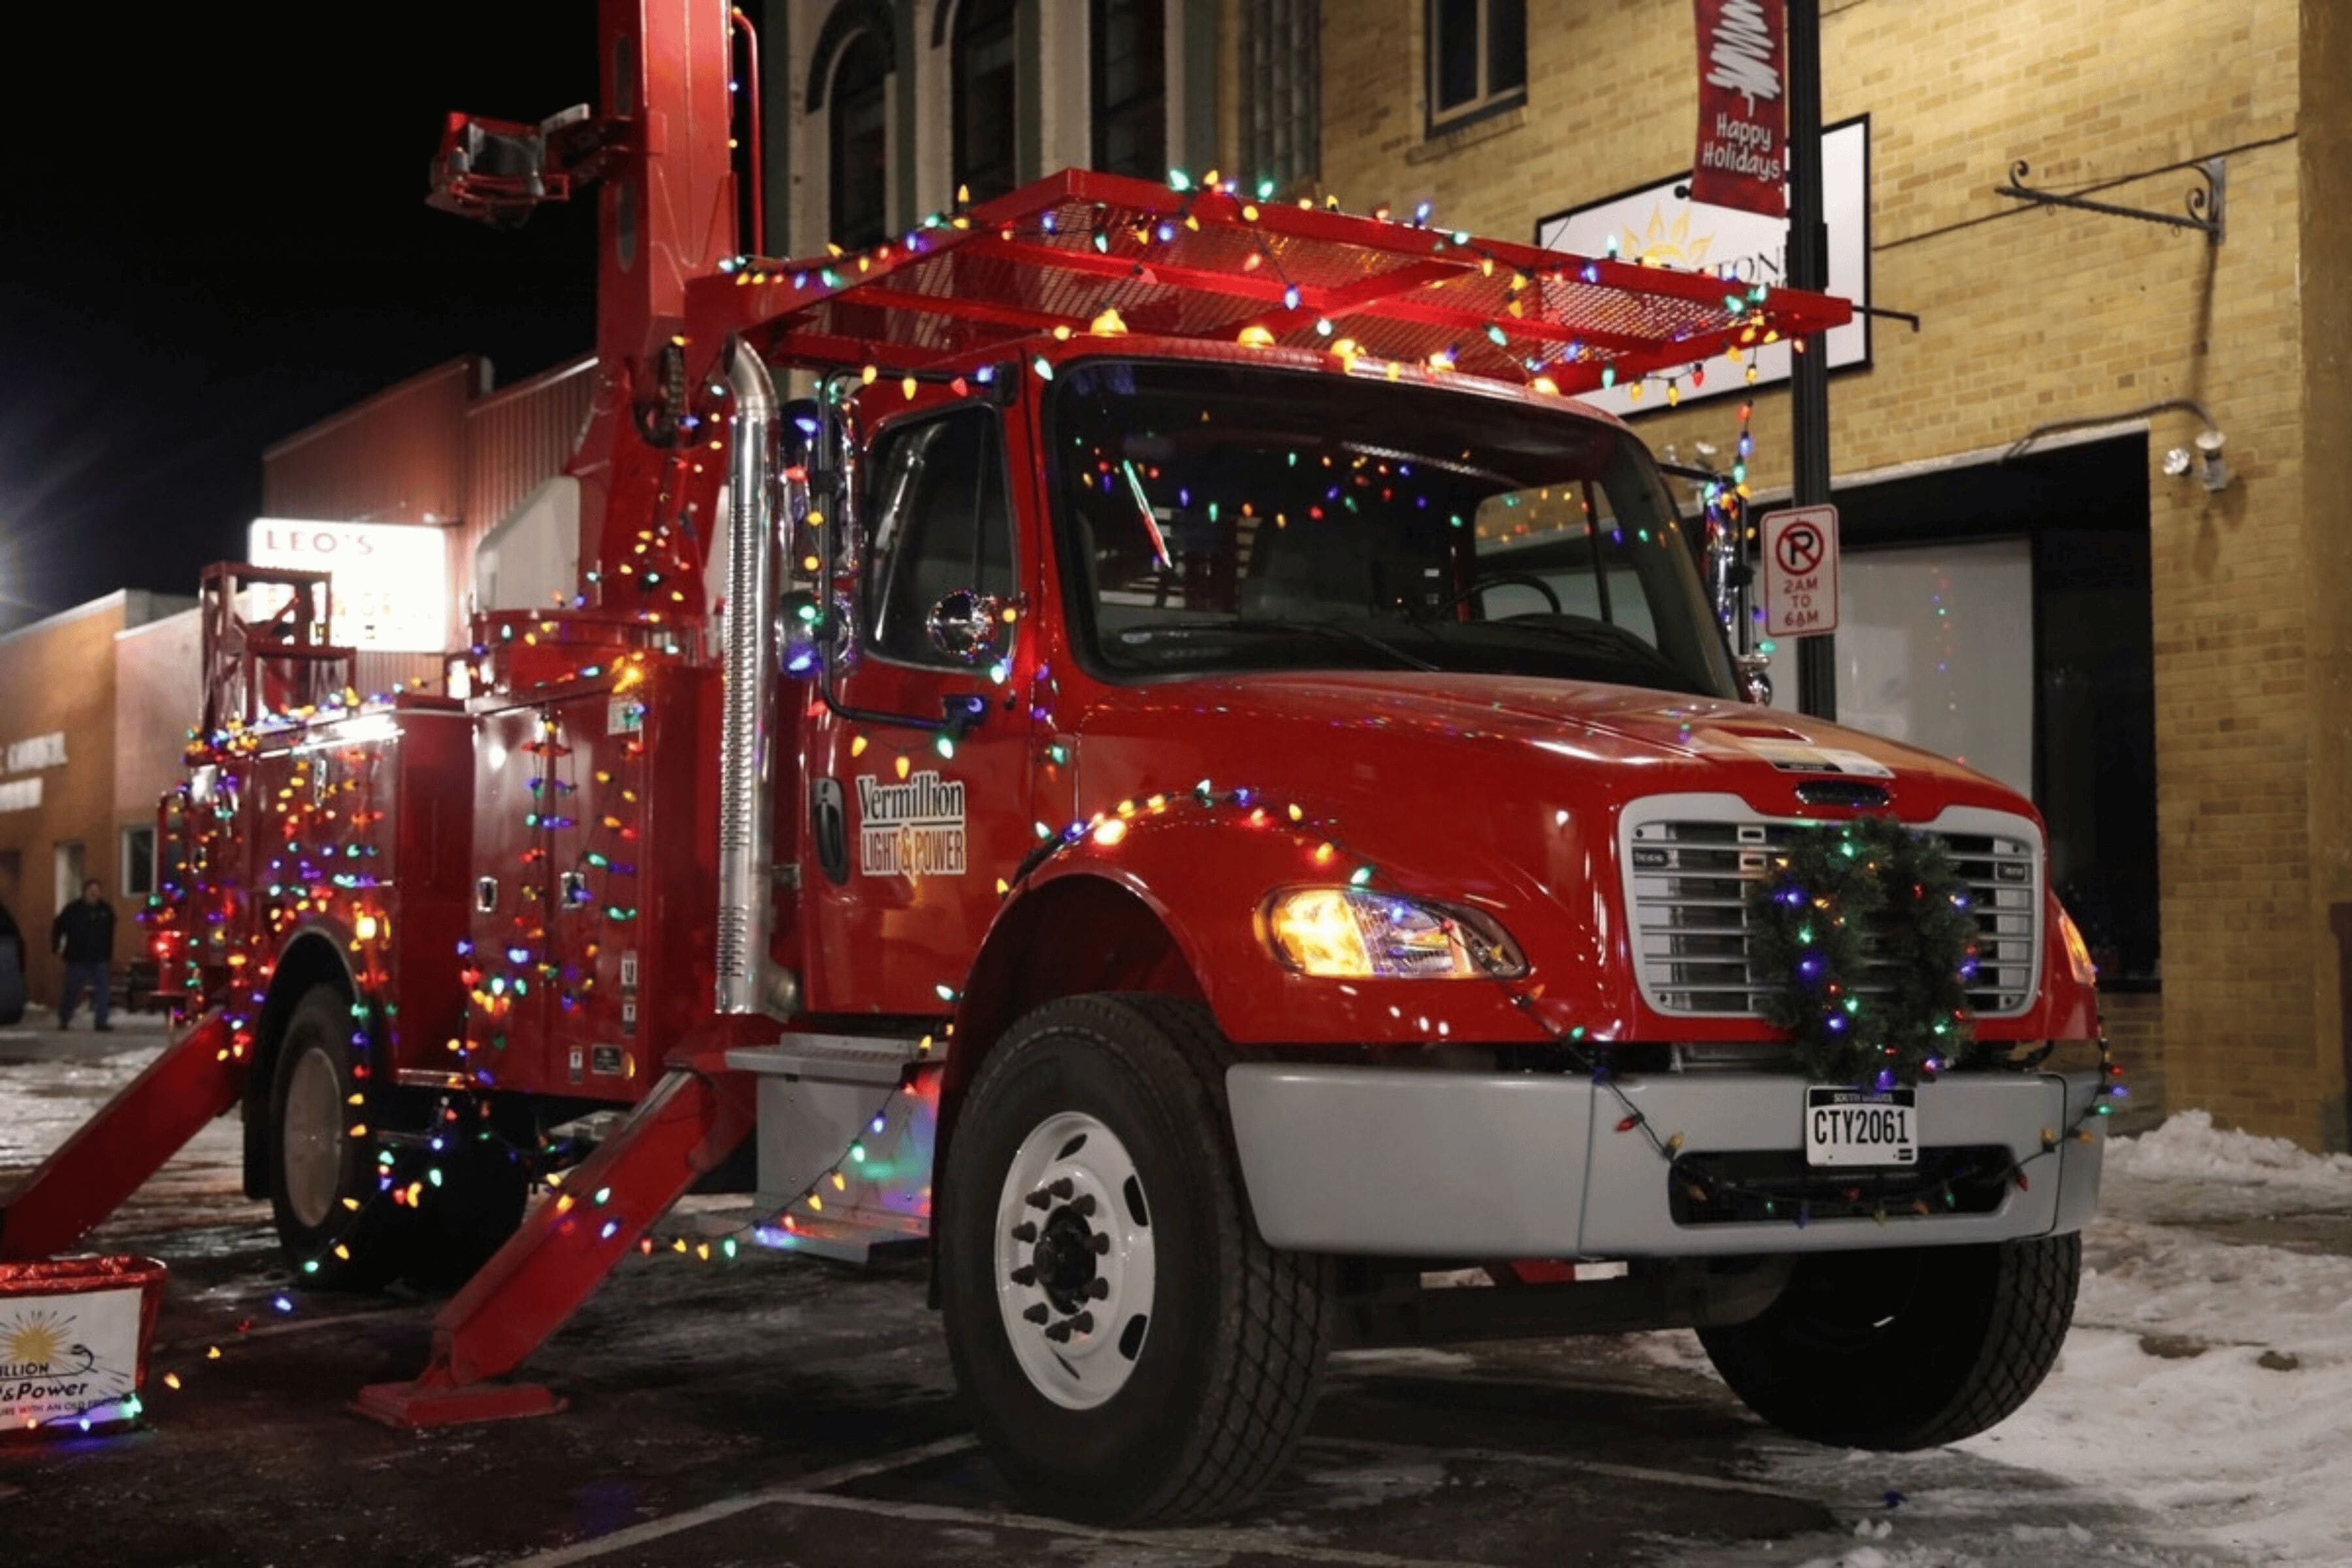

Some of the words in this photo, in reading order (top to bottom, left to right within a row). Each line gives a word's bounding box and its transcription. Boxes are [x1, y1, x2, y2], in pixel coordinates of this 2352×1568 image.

[1716, 112, 1771, 152] Happy
[1703, 140, 1781, 182] Holidays
[267, 529, 374, 556] LEO'S
[1791, 595, 1812, 608] TO
[857, 774, 963, 819] Vermillion
[862, 832, 898, 872] LIGHT
[915, 830, 963, 872] POWER
[1814, 1109, 1909, 1145] CTY2061
